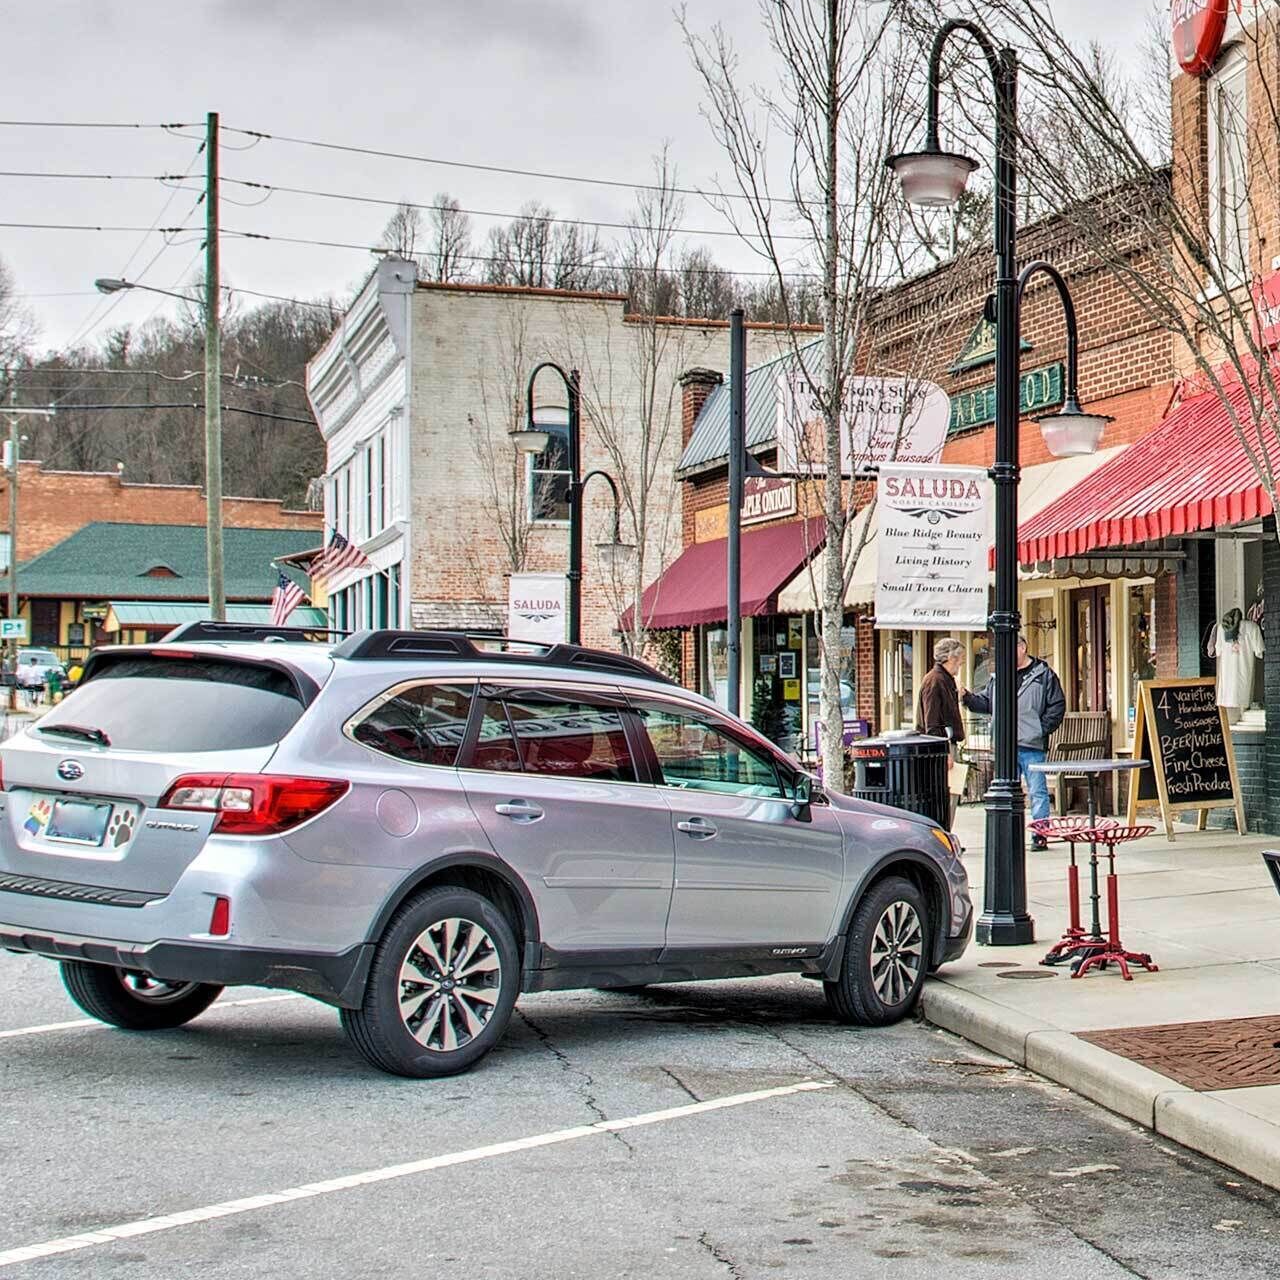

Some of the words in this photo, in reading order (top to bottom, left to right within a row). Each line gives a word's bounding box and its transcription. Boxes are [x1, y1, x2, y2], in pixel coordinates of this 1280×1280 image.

[885, 477, 982, 500] SALUDA
[762, 486, 791, 513] ONION
[885, 528, 909, 538] Blue
[912, 528, 943, 540] Ridge
[945, 529, 983, 542] Beauty
[895, 554, 929, 567] Living
[932, 556, 973, 569] History
[881, 582, 912, 593] Small
[916, 583, 944, 594] Town
[947, 583, 984, 595] Charm
[513, 599, 561, 610] SALUDA
[912, 608, 930, 618] Est.
[1157, 690, 1171, 719] 4
[1174, 715, 1220, 732] Sausages
[1161, 730, 1222, 755] BEER/WINE
[1164, 755, 1192, 775] Fine
[1191, 751, 1227, 768] Cheese
[1167, 774, 1194, 795] Fresh
[1191, 772, 1232, 793] Produce
